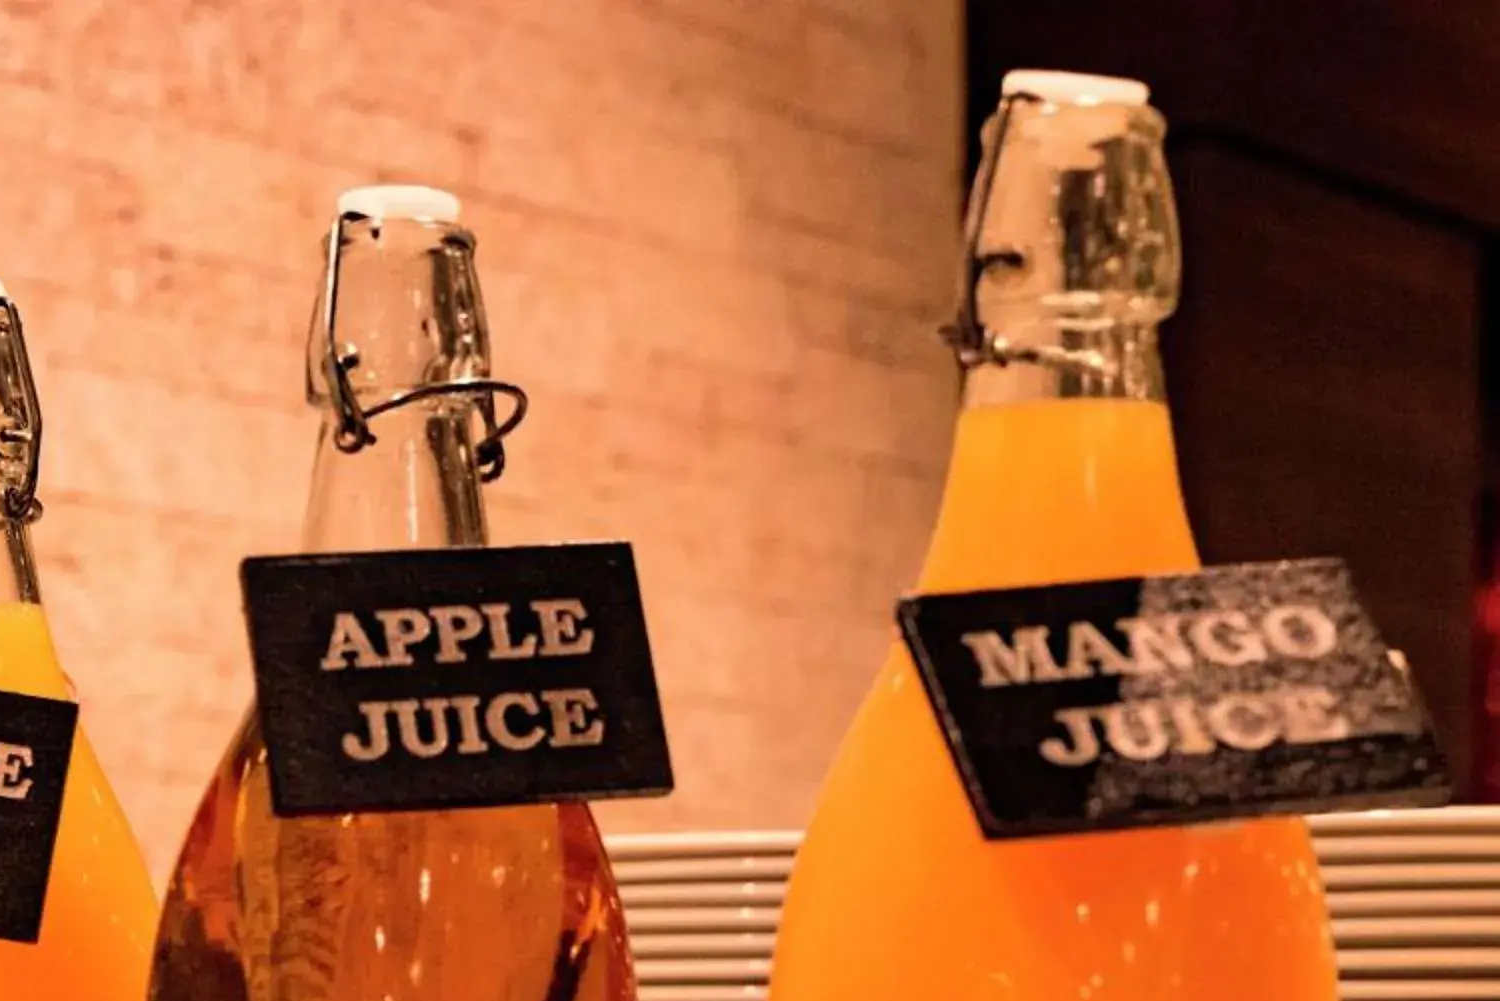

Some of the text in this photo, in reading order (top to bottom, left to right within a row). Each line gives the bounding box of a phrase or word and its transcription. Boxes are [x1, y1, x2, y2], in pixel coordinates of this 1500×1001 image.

[321, 599, 594, 671] APPLE
[961, 606, 1338, 687] MANGO
[342, 688, 604, 761] JUICE
[1038, 690, 1349, 767] JUICE
